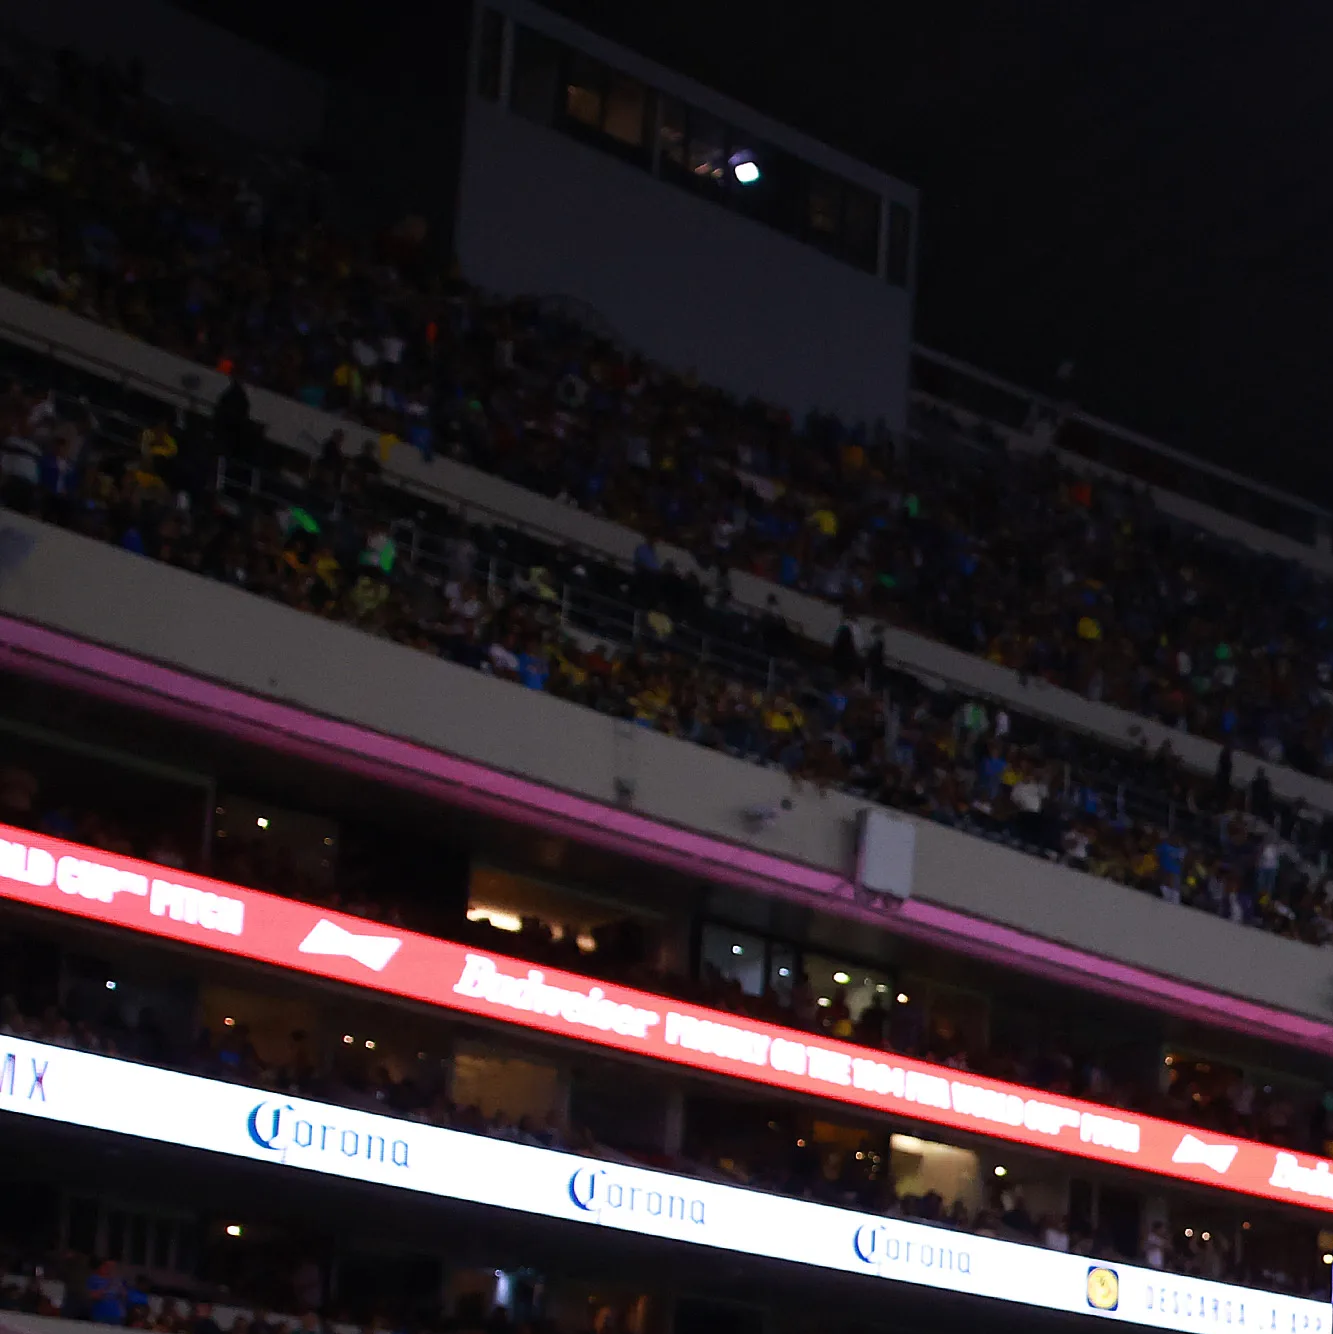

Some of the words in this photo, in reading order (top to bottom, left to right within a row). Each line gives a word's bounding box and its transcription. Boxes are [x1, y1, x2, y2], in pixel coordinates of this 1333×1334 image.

[453, 953, 660, 1039] Budweiser
[246, 1100, 411, 1168] Corona
[567, 1166, 706, 1226] Corona
[852, 1224, 972, 1276] Corona
